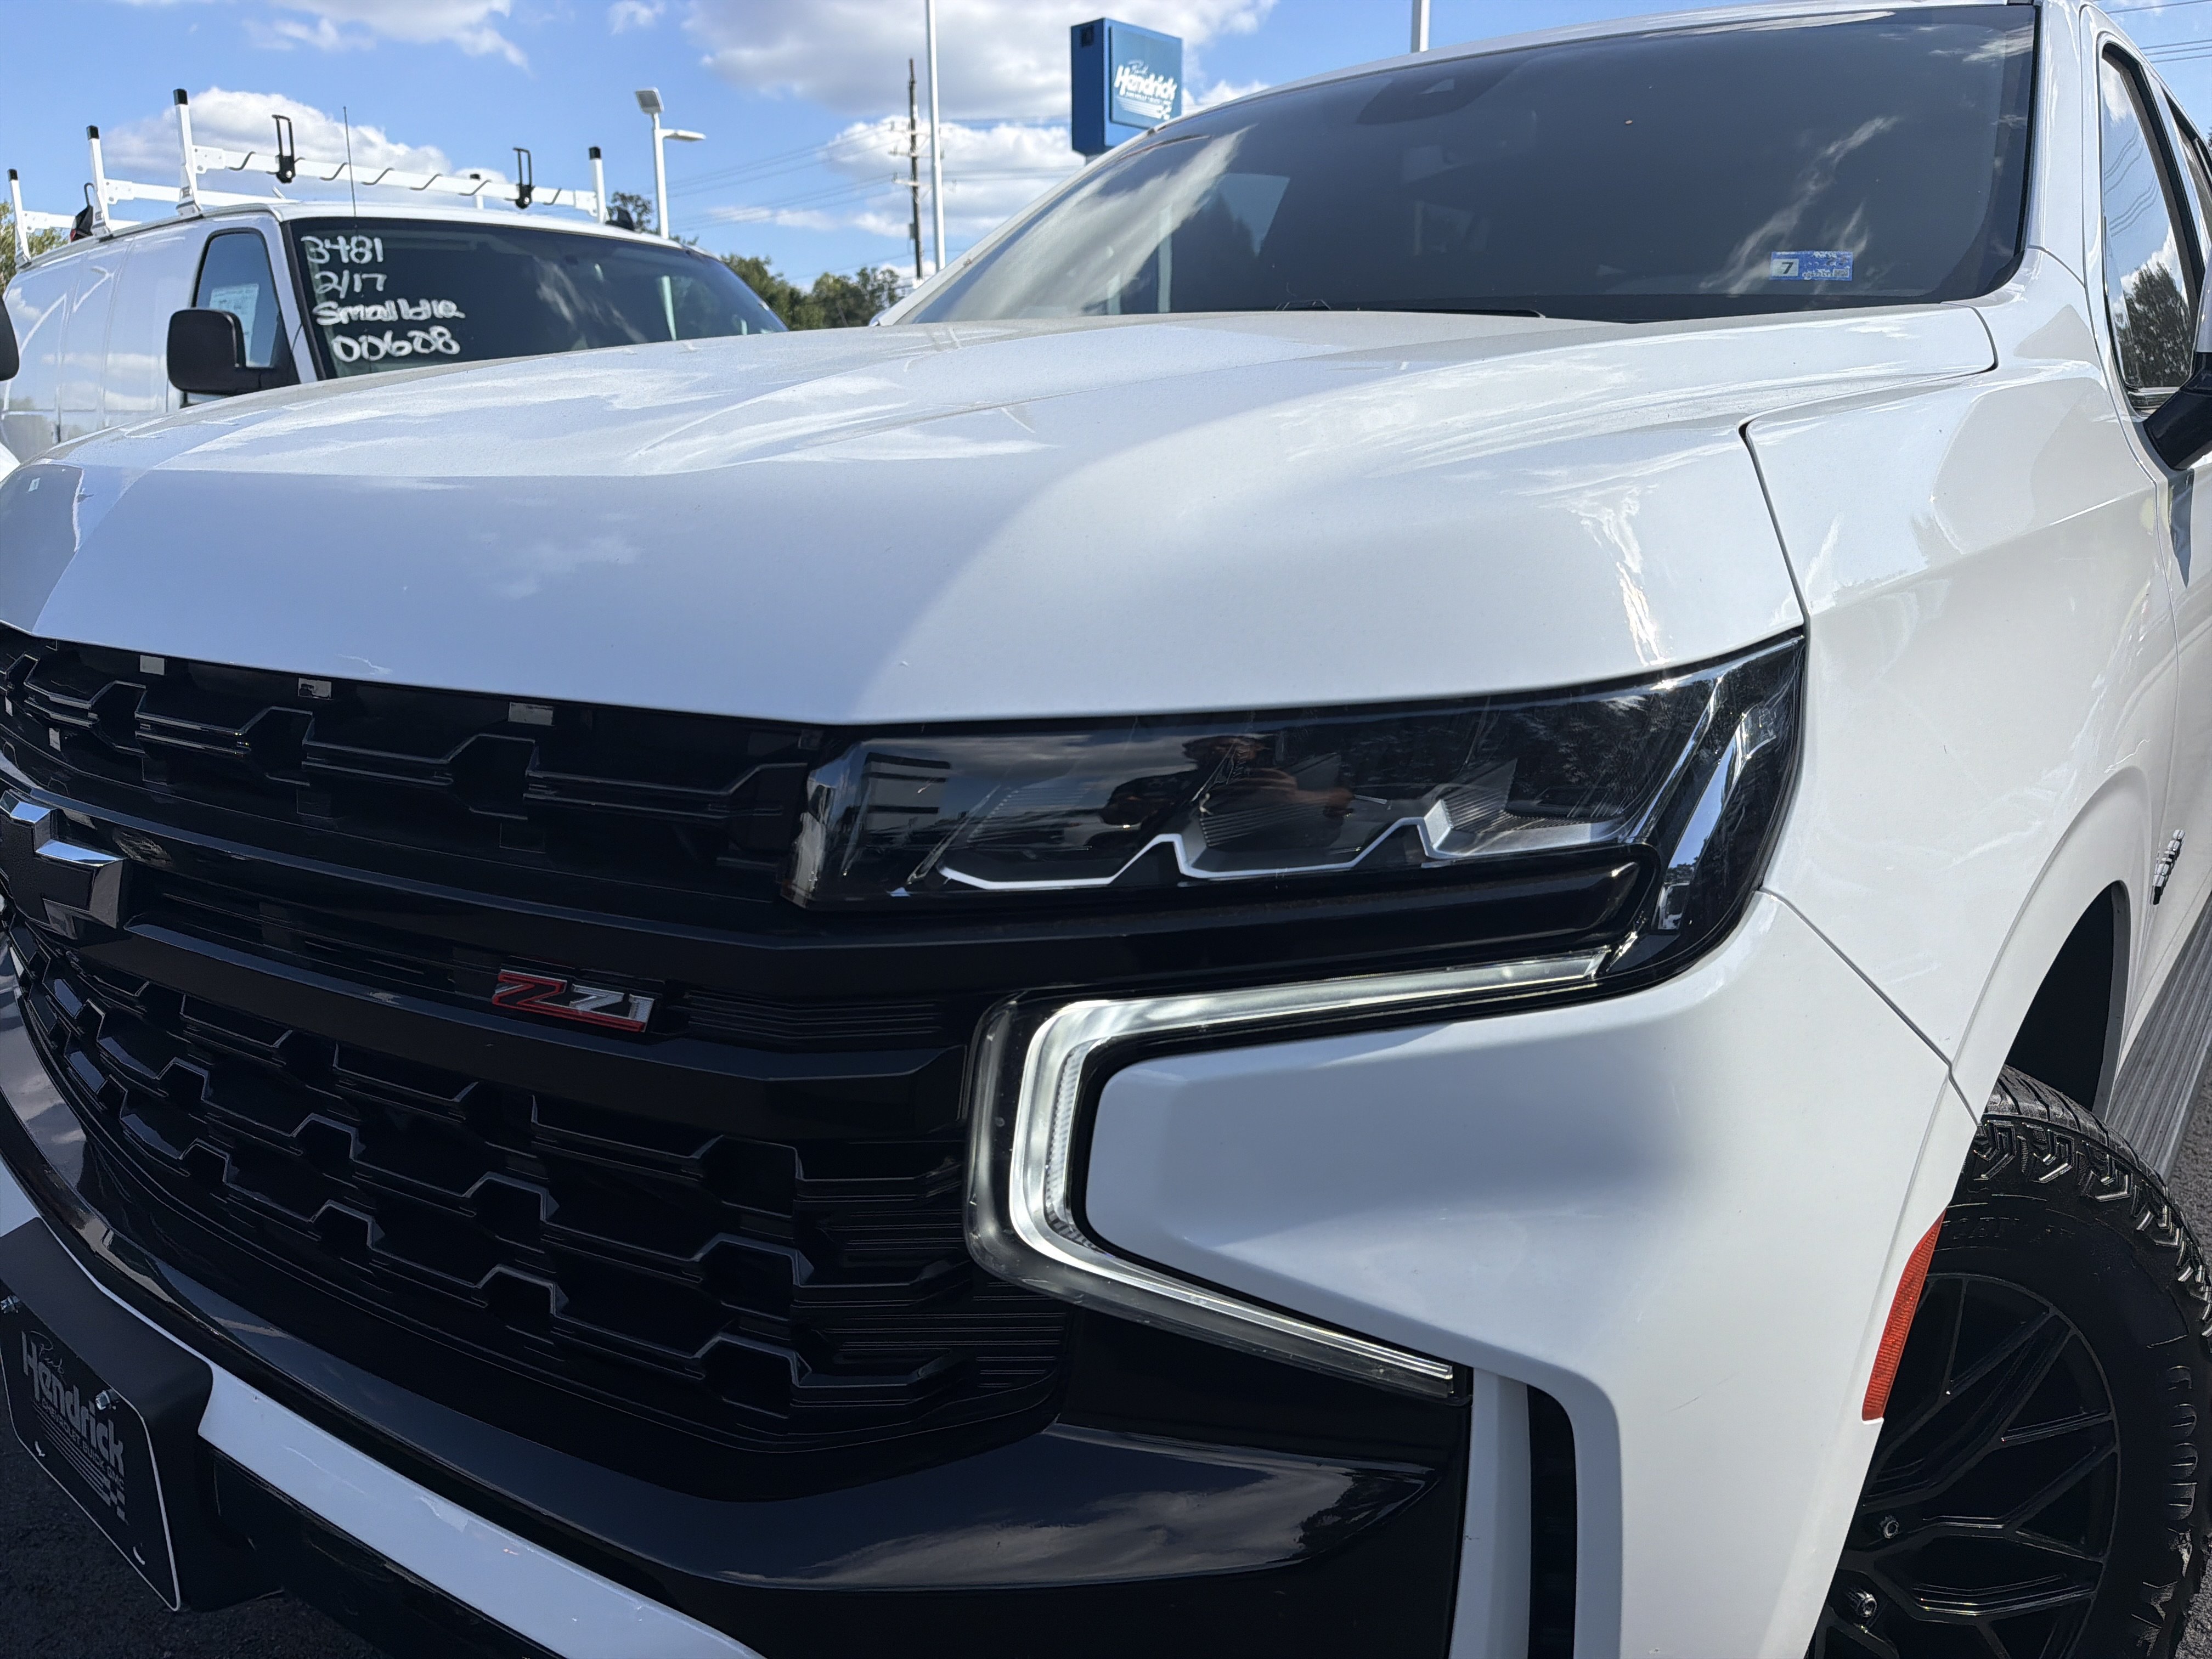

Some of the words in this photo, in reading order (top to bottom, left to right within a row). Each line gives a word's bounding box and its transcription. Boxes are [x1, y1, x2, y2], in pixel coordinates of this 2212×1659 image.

[1114, 65, 1177, 100] Hendrick
[301, 235, 383, 264] 3481
[314, 269, 387, 299] 2/17
[1781, 262, 1794, 274] 7
[492, 968, 654, 1032] Z71
[21, 1330, 125, 1477] Hendrick
